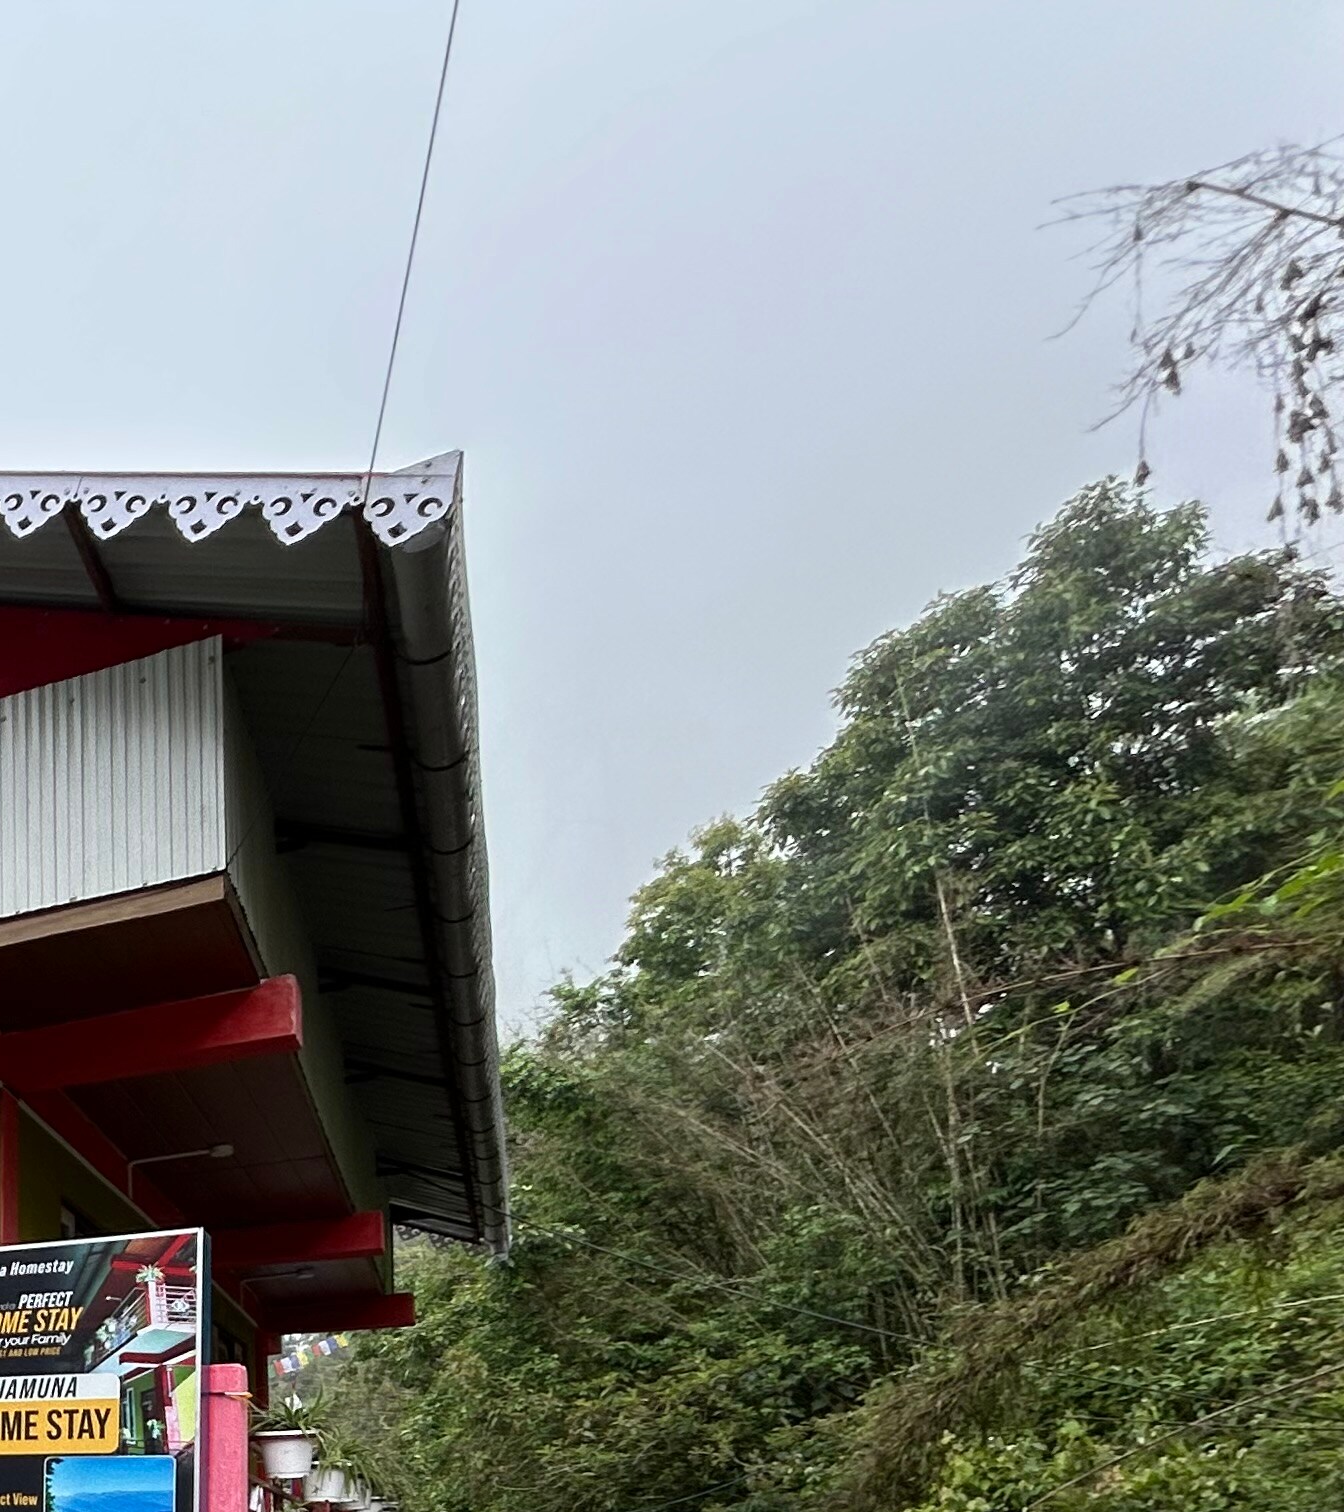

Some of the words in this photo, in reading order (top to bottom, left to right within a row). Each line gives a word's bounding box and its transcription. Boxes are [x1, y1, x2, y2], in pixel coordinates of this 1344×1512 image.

[9, 1259, 74, 1275] Homestay
[18, 1291, 74, 1309] PERFECT
[33, 1306, 84, 1333] STAY
[2, 1336, 30, 1348] your
[31, 1332, 72, 1346] Family
[8, 1348, 23, 1357] AND
[23, 1347, 39, 1357] LOW
[40, 1346, 61, 1356] PRICE
[46, 1408, 111, 1441] STAY
[12, 1492, 38, 1506] View
